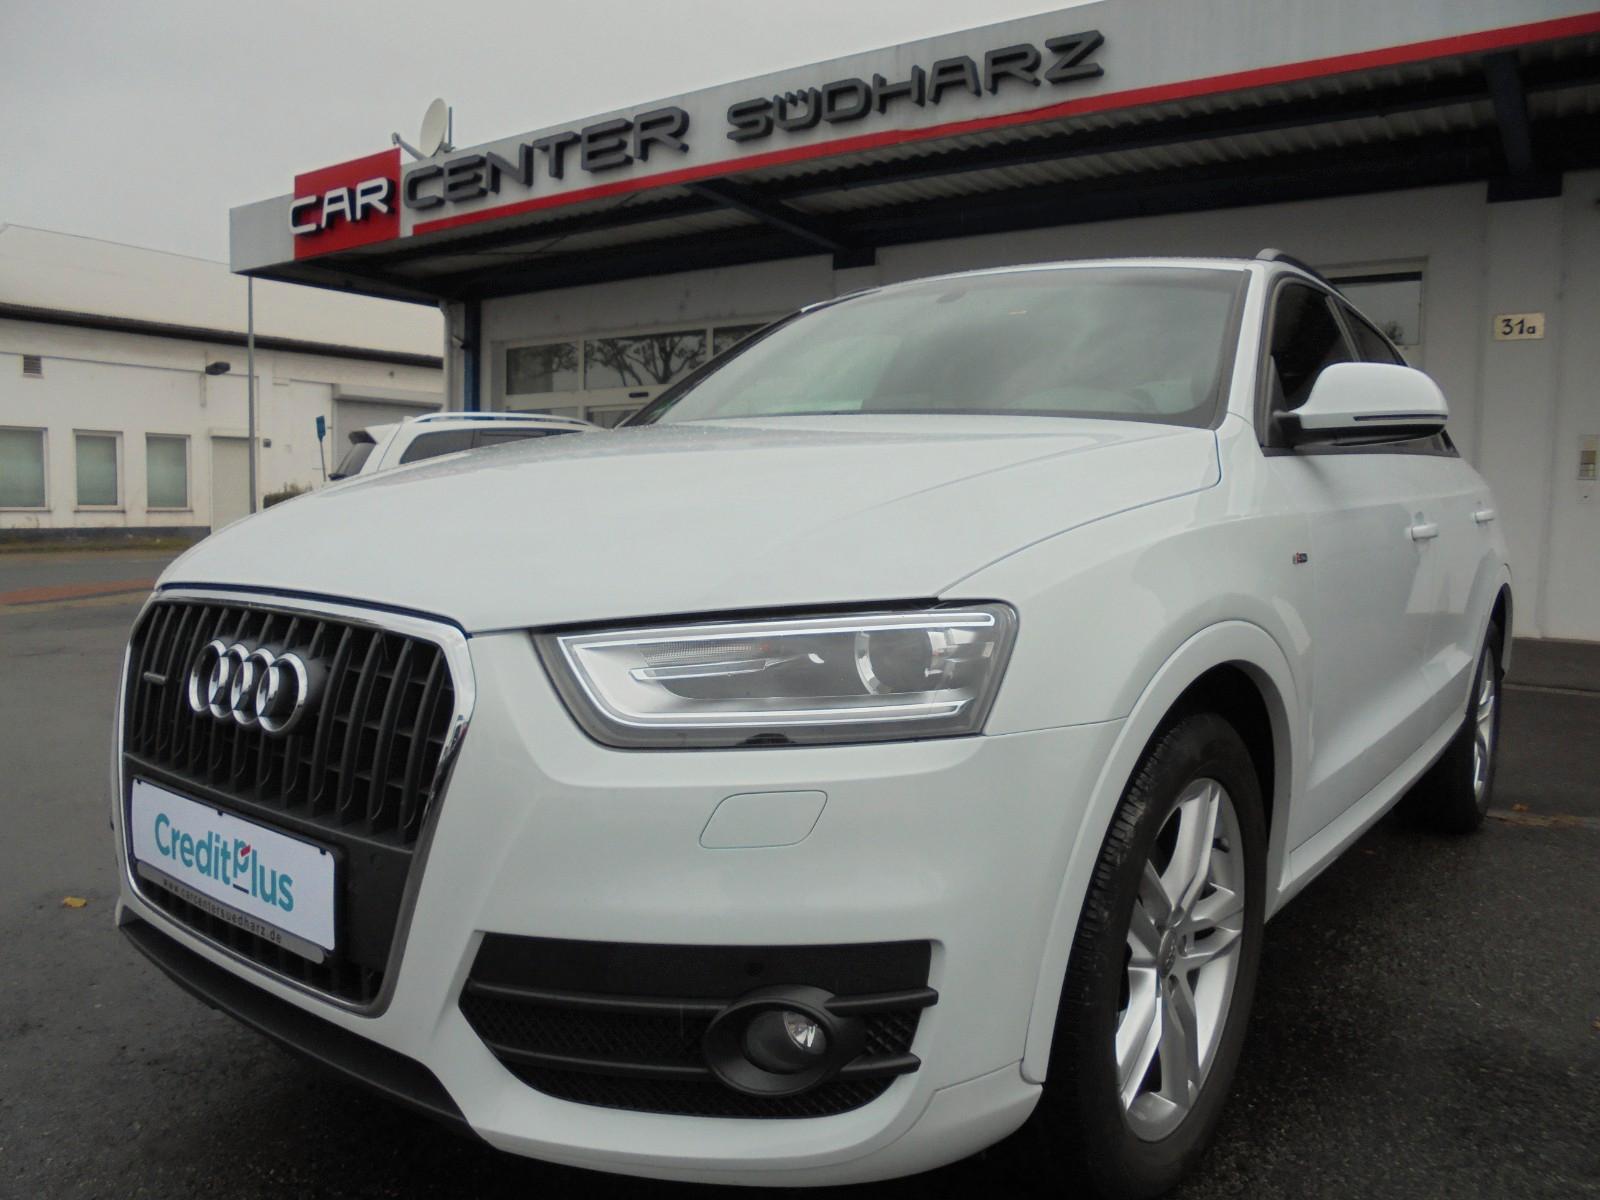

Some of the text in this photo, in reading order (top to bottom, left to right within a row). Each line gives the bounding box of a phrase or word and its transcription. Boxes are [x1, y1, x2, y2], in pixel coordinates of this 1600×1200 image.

[288, 29, 1105, 236] CAR CENTER SÜDHARZ
[1501, 318, 1536, 336] 31a
[154, 812, 295, 913] CreditPlus
[162, 878, 283, 945] www.carcentersuedharz.de
